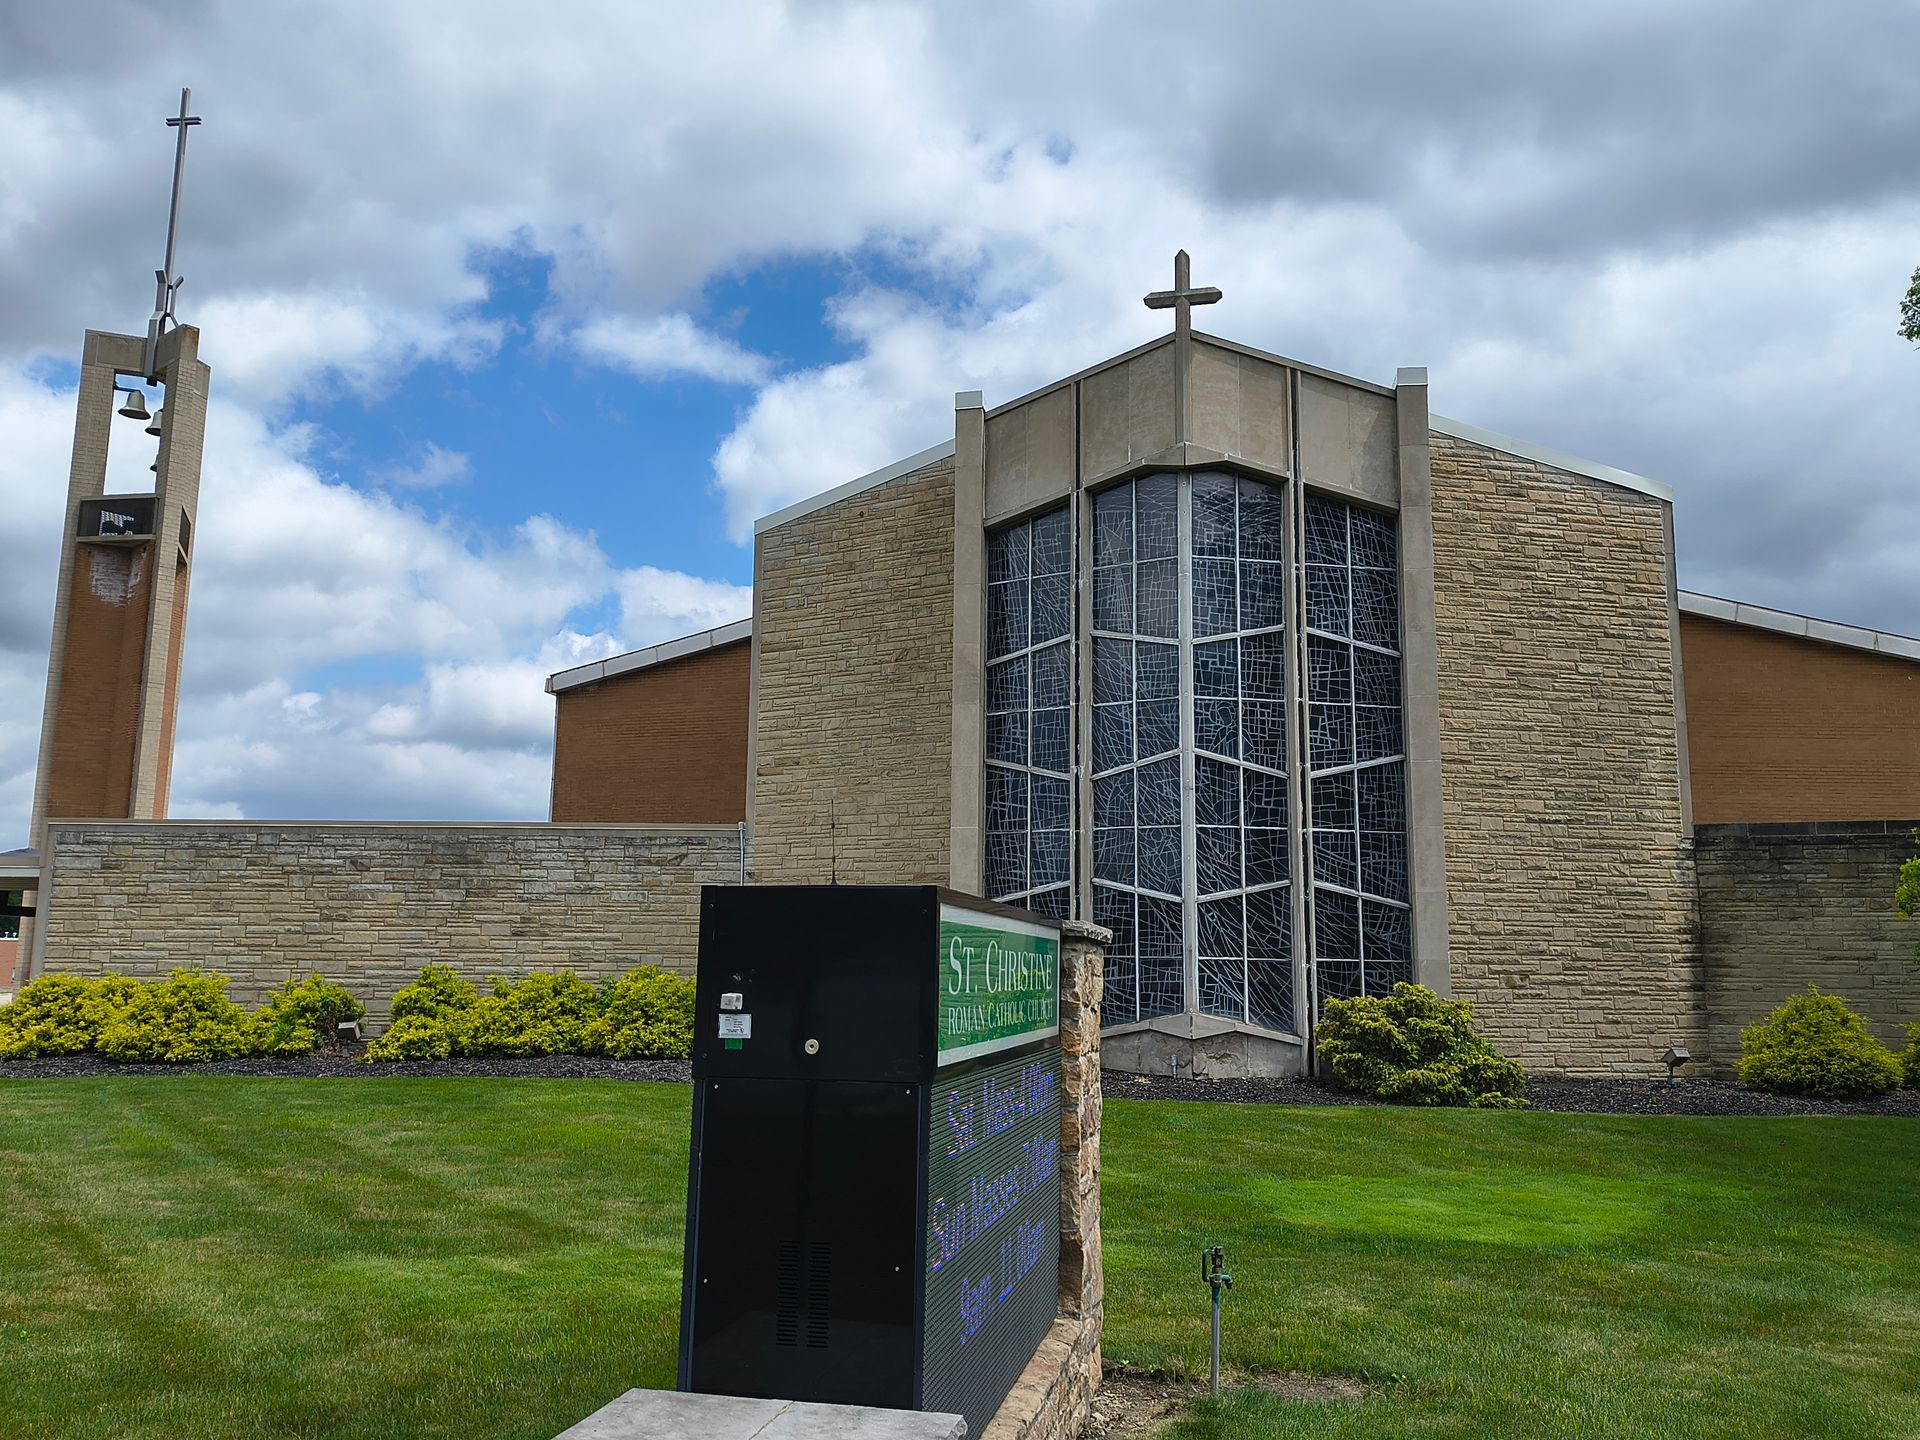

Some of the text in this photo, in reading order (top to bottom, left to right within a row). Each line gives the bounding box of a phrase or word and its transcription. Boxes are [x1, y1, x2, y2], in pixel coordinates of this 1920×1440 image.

[949, 936, 1053, 995] ST. CHRISTINE
[948, 997, 1053, 1035] ROMAN CATHOLIC CHURCH
